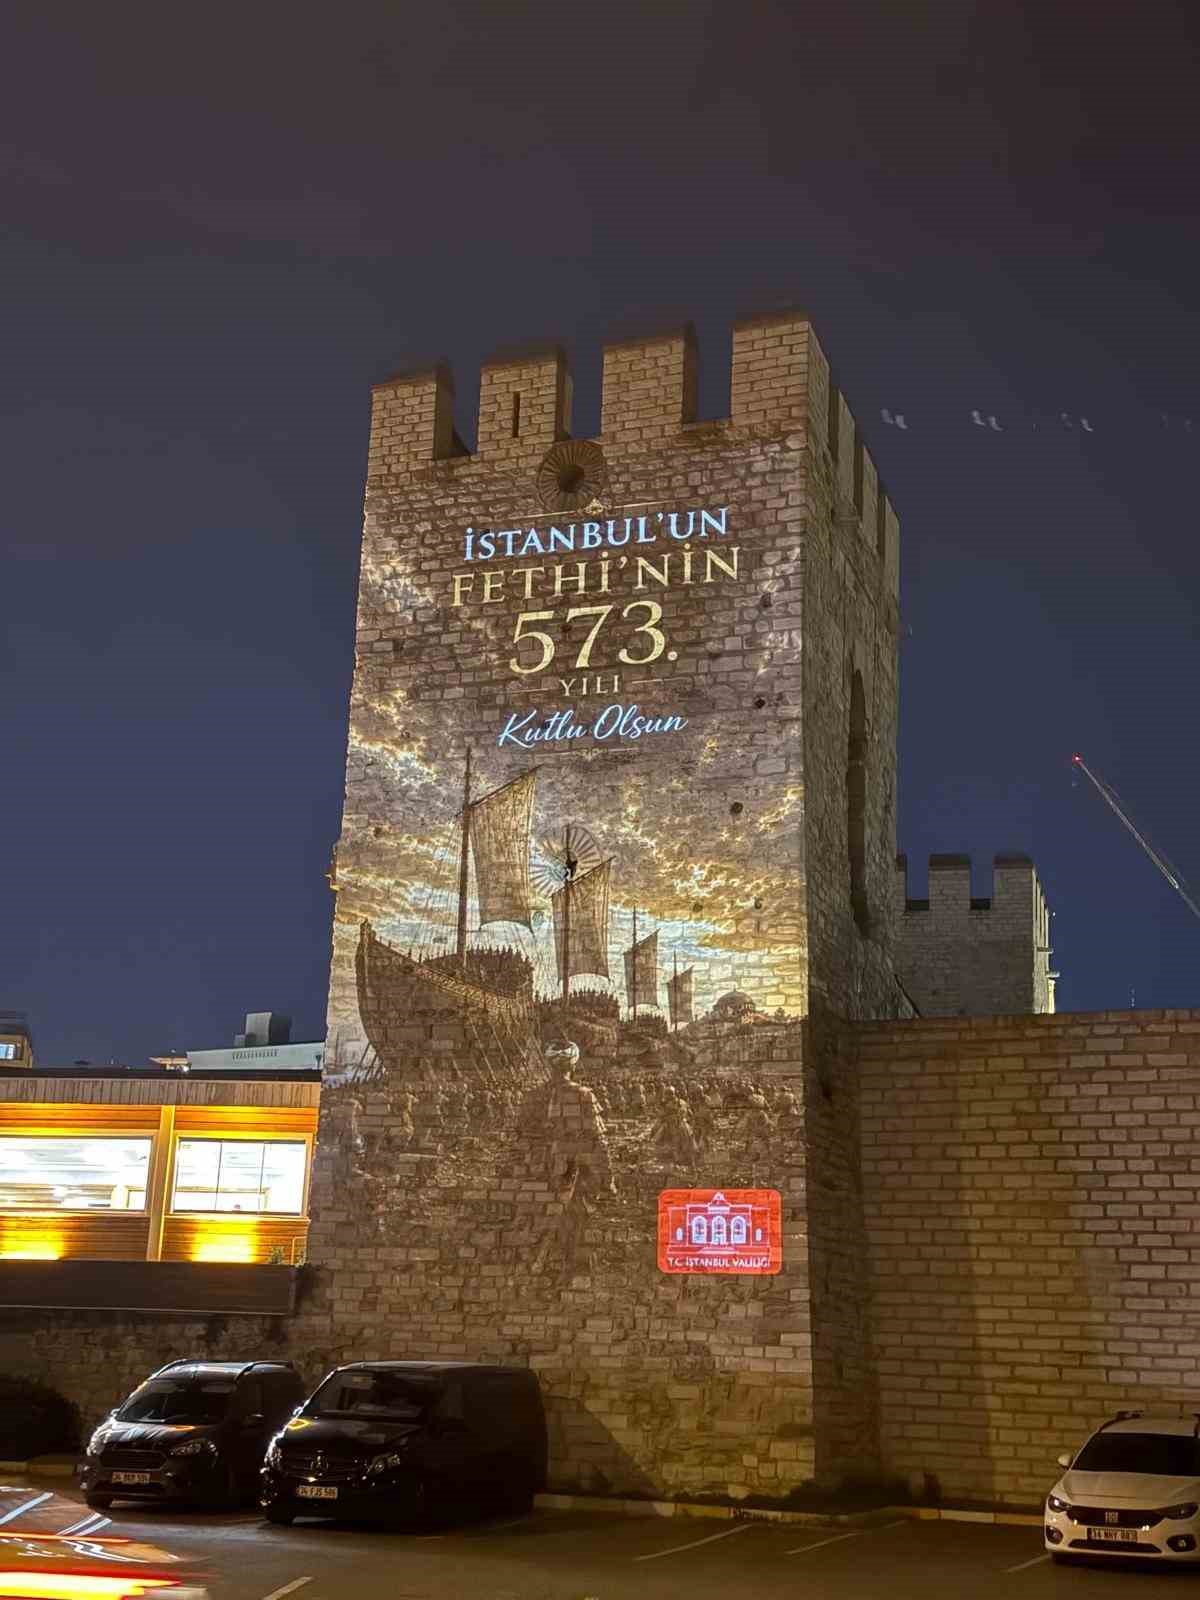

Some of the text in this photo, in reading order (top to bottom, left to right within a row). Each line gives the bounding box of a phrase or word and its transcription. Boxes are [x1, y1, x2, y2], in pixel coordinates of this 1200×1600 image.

[464, 508, 729, 560] İSTANBUL'UN
[452, 543, 740, 606] FETHİ'NİN
[509, 601, 678, 674] 573.
[560, 675, 620, 696] YILI
[498, 704, 688, 749] Kutlu Olsun
